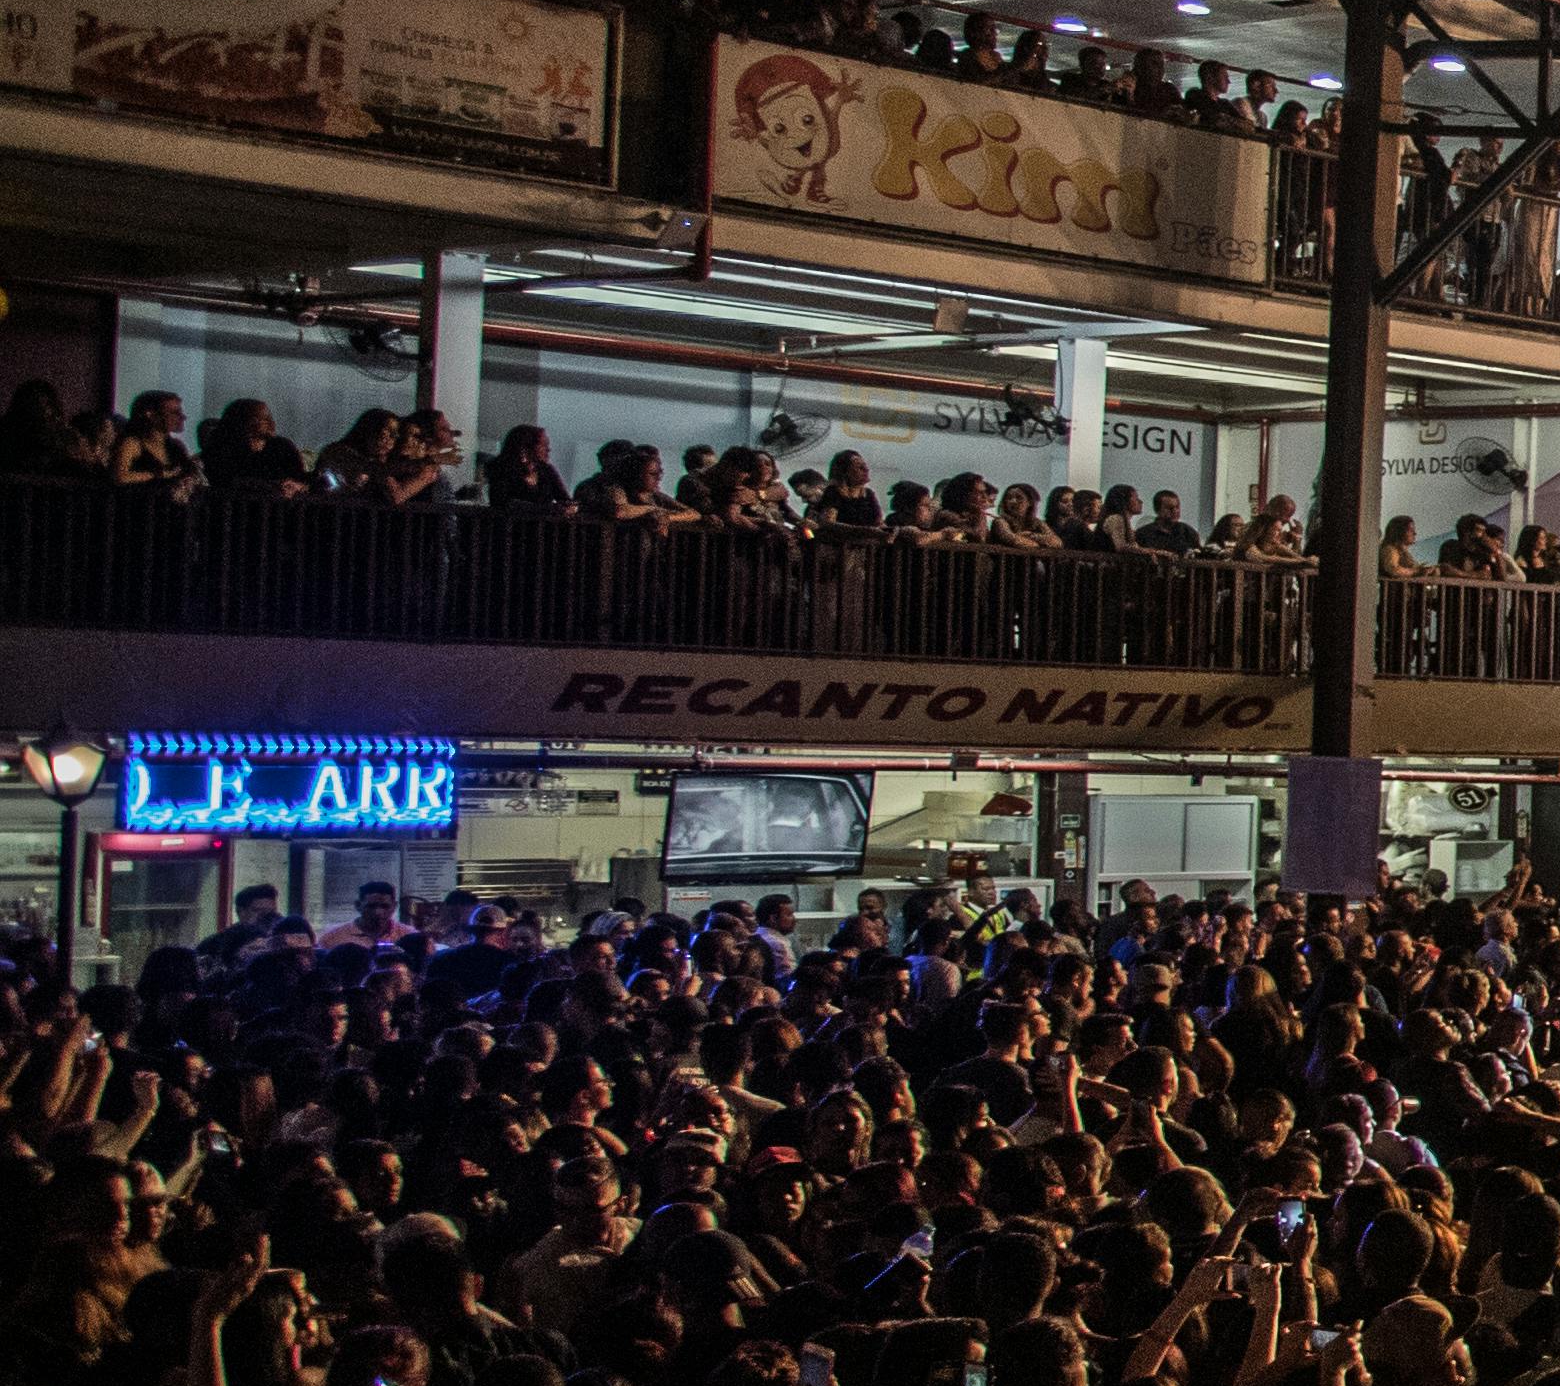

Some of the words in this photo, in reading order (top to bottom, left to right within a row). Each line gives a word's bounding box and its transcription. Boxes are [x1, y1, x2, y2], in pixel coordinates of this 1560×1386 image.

[872, 86, 1160, 240] Kim
[1429, 455, 1485, 474] DESIG
[550, 673, 987, 722] RECANTO
[998, 687, 1275, 730] NATIVO
[1456, 789, 1483, 808] 51
